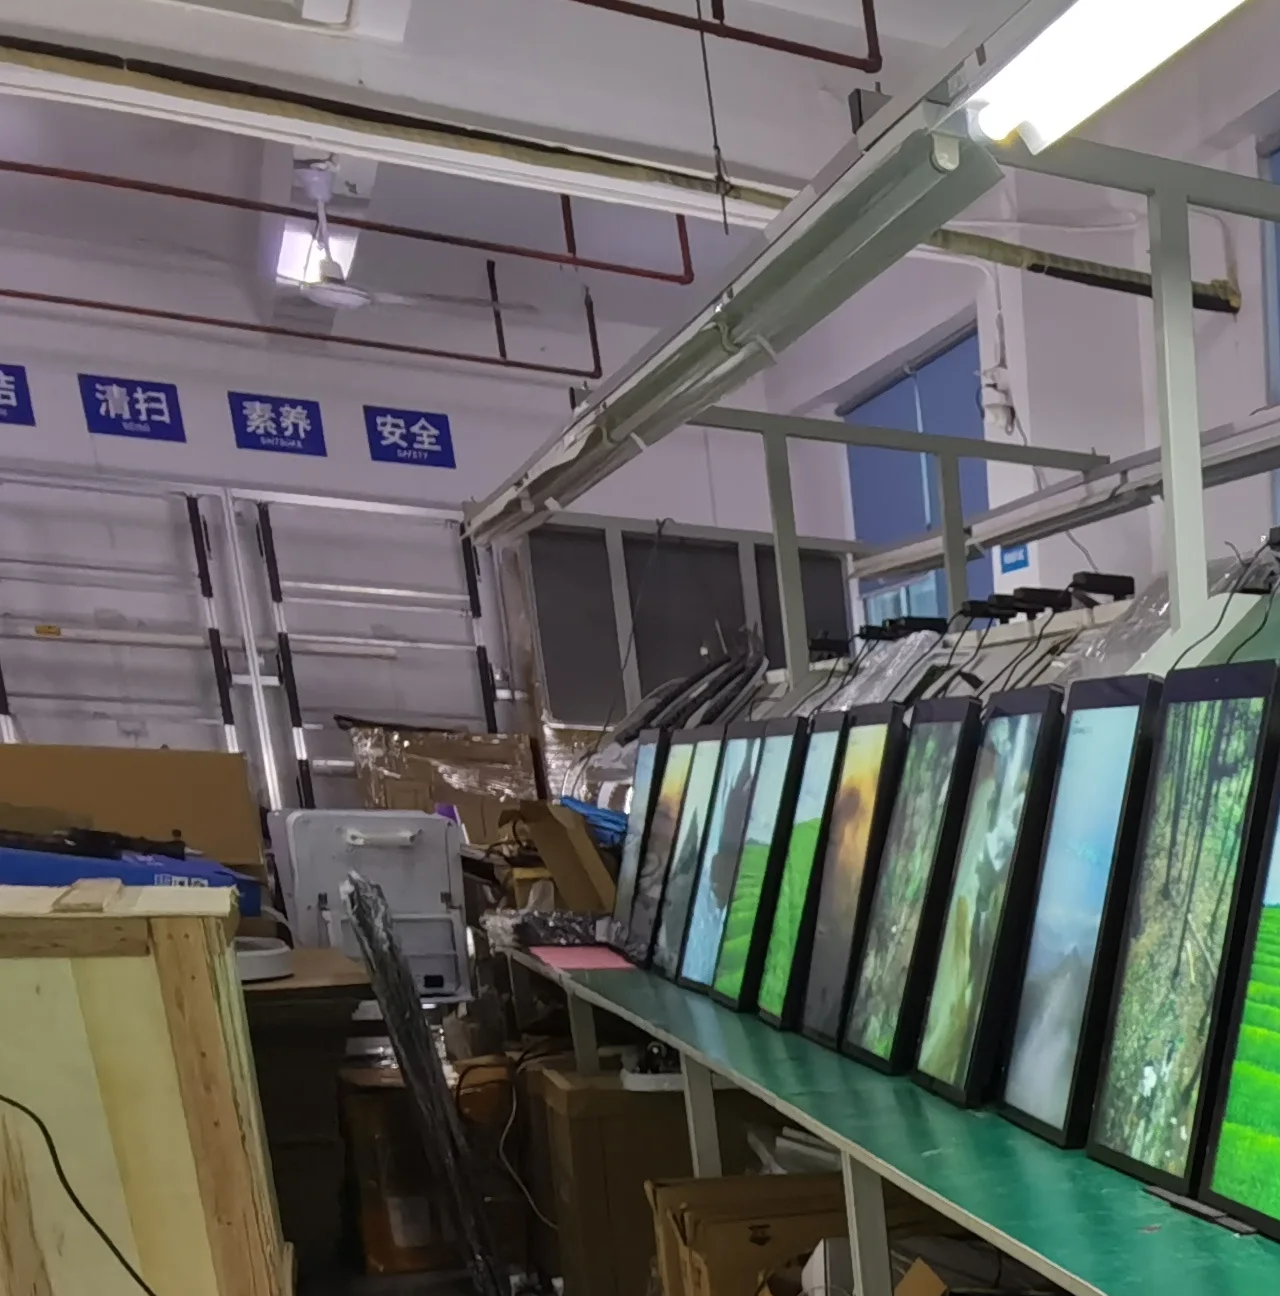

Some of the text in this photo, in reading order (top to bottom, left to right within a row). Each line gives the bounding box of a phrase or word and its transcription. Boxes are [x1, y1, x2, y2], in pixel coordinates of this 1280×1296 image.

[95, 383, 171, 424] 清扫
[242, 400, 312, 439] 素养
[376, 414, 442, 451] 安全
